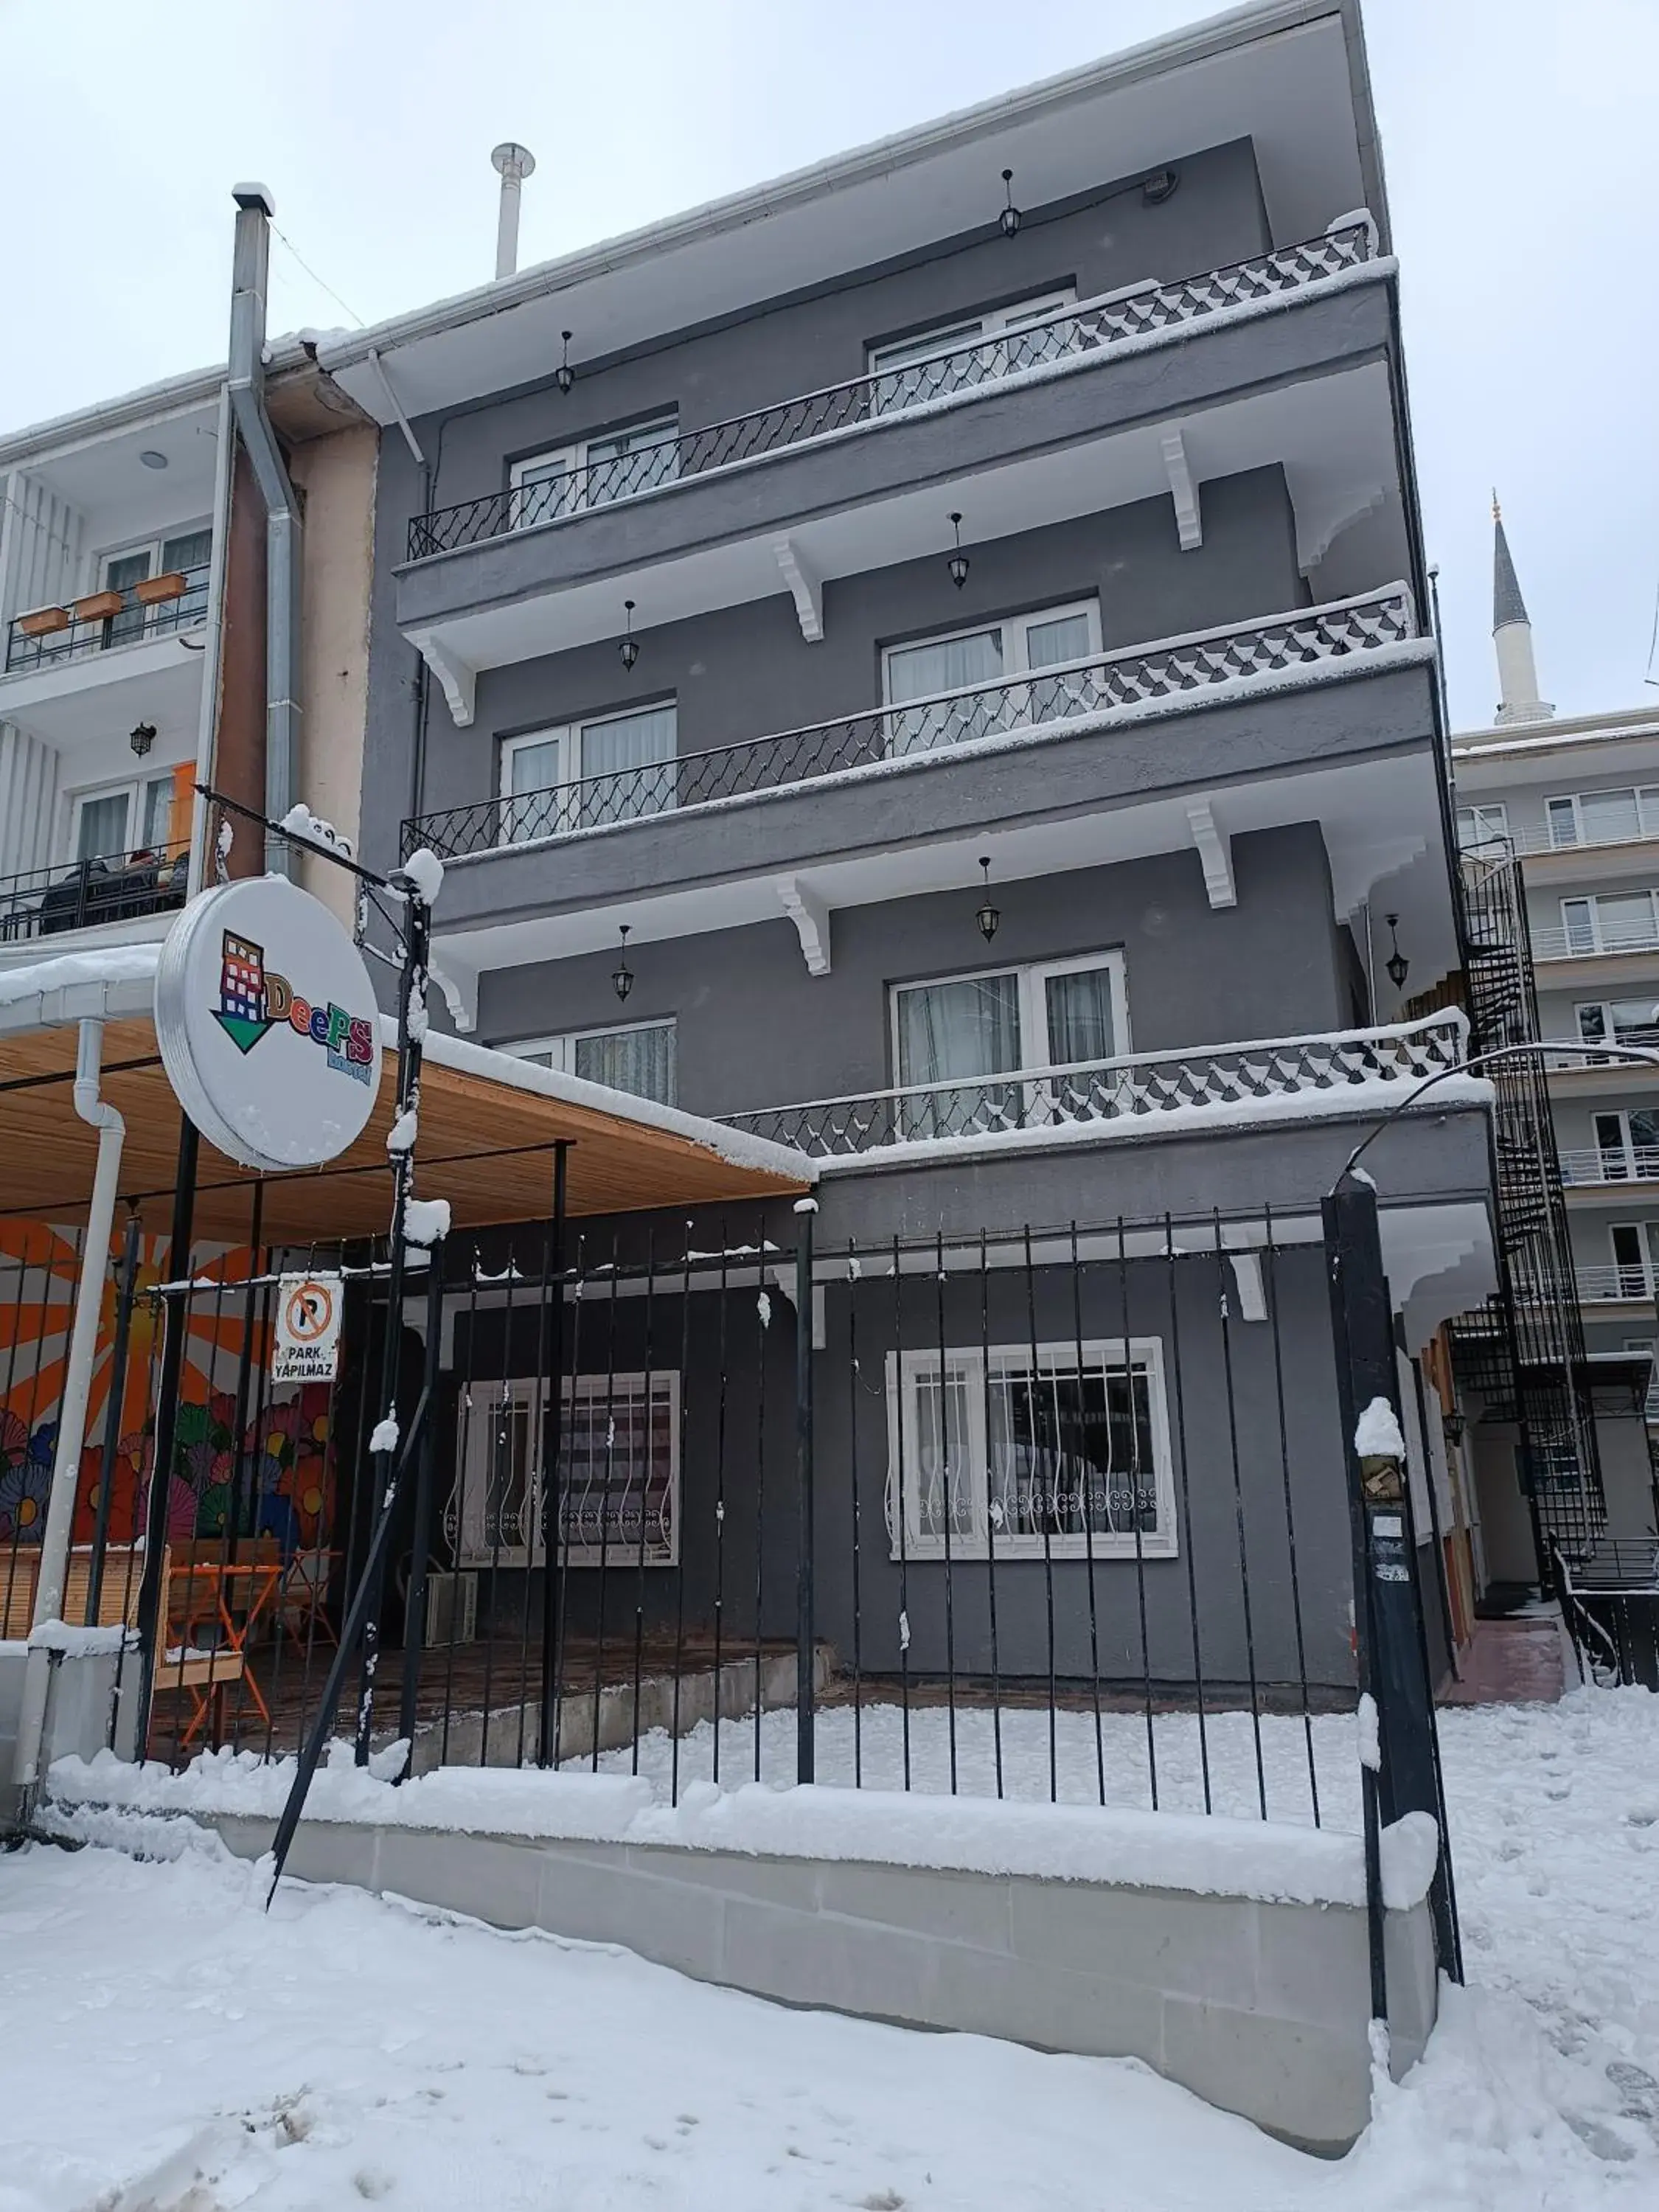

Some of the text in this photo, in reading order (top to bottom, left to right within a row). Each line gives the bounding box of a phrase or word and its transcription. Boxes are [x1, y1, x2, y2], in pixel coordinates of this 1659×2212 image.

[299, 1299, 318, 1326] P
[288, 1346, 321, 1360] PARK
[275, 1363, 333, 1377] YAPILMAZ
